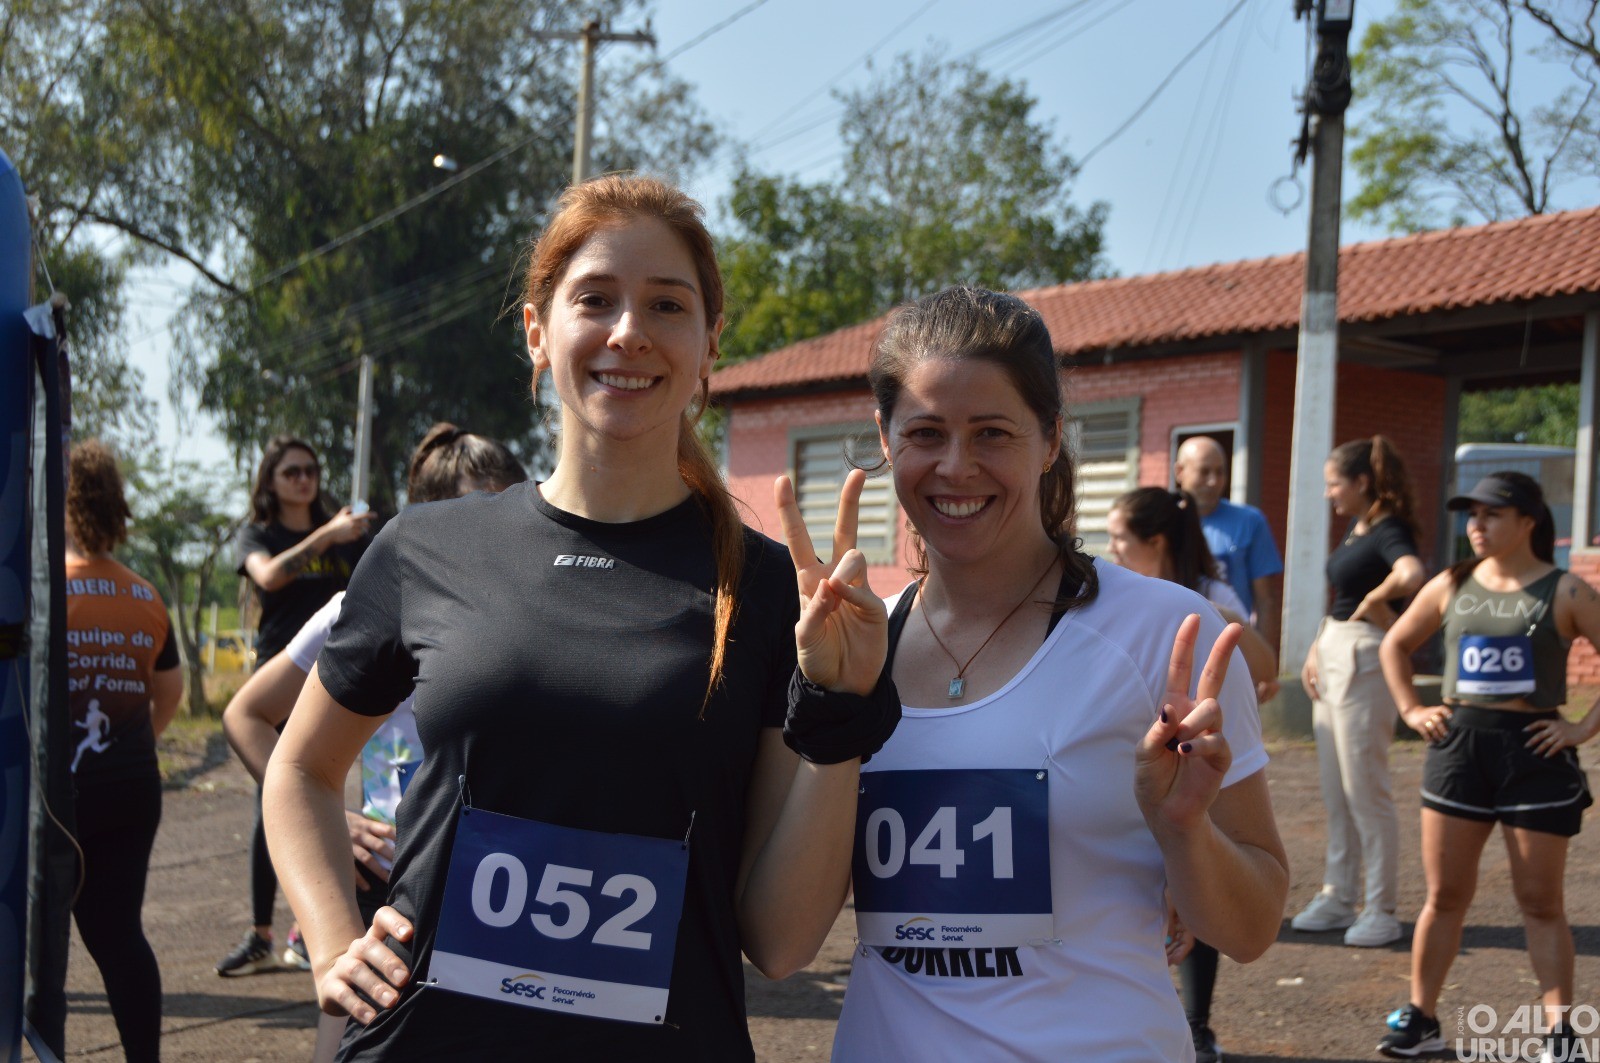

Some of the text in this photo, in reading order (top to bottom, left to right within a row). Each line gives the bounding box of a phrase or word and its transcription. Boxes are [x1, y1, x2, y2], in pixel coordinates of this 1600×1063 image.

[575, 555, 615, 569] FIBRA
[131, 582, 154, 601] RS
[131, 630, 154, 648] de
[67, 651, 137, 670] Corrida
[1462, 645, 1525, 673] 026
[94, 673, 146, 694] Forma
[865, 806, 1014, 879] 041
[470, 851, 658, 951] 052
